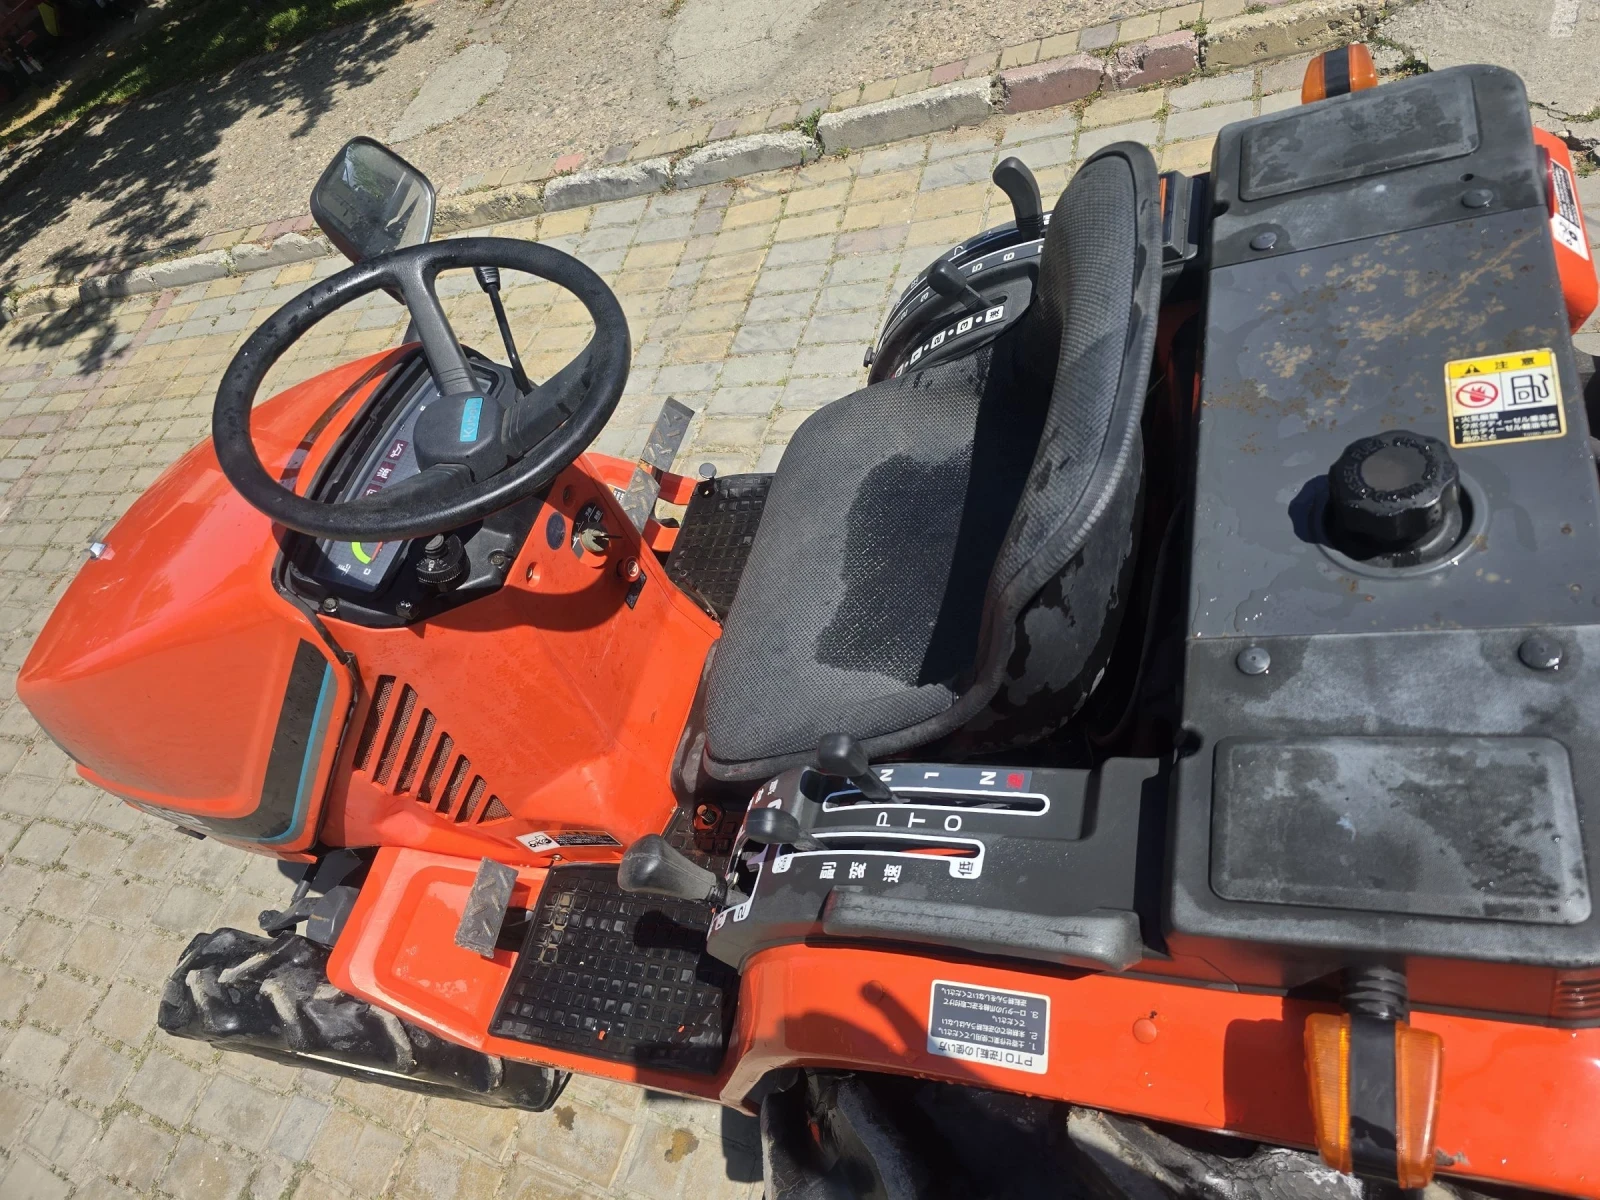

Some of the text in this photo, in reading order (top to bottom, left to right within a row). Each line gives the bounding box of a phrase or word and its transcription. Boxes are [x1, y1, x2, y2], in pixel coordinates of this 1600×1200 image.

[819, 861, 903, 883] 副変速
[957, 860, 974, 876] 低
